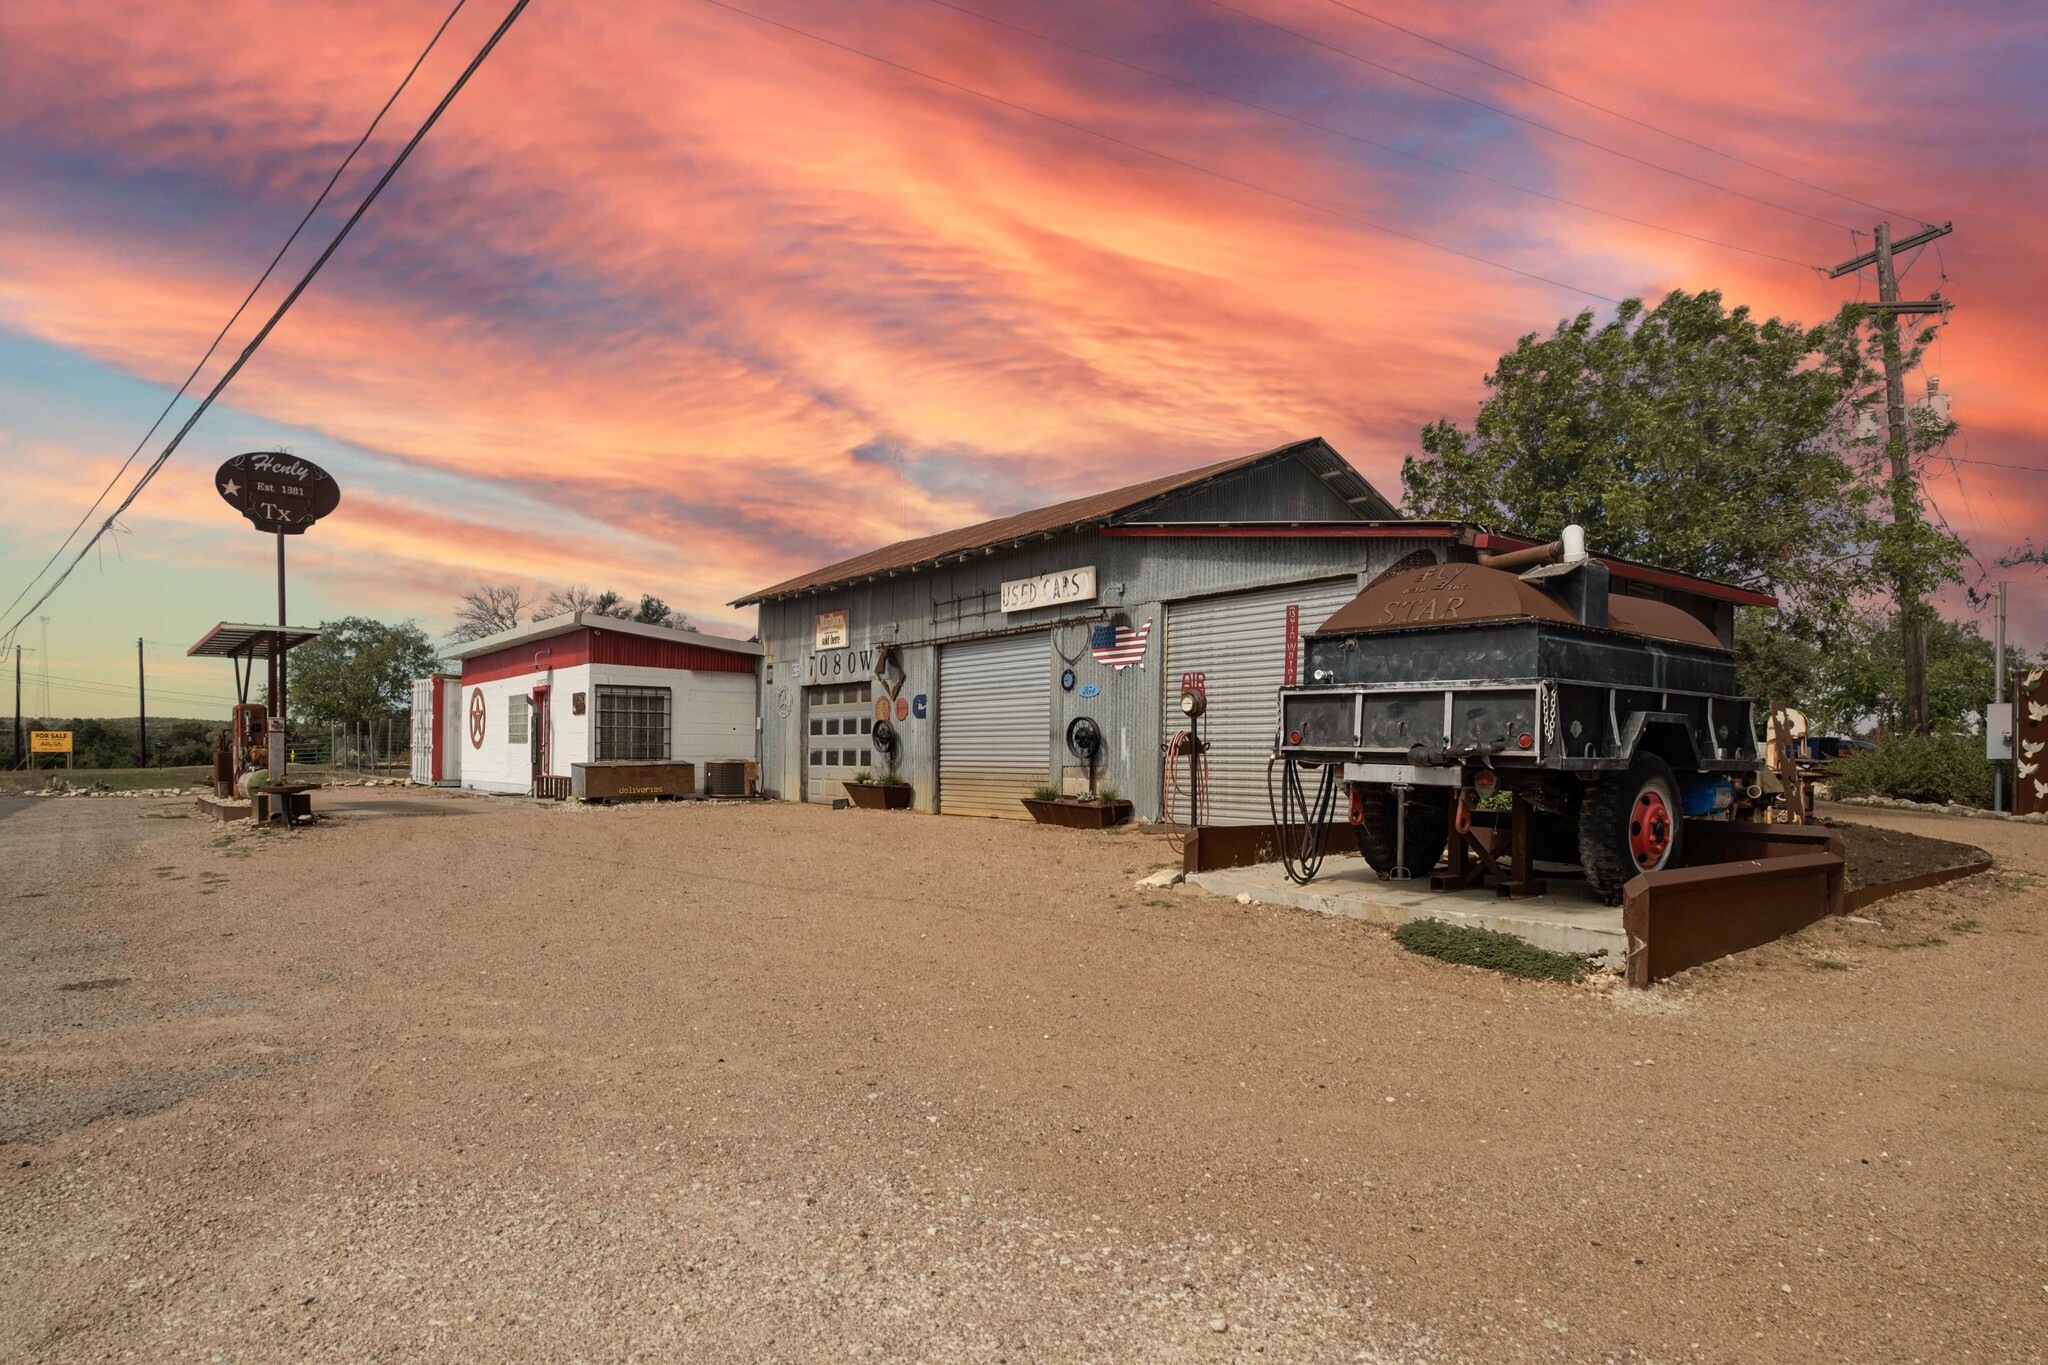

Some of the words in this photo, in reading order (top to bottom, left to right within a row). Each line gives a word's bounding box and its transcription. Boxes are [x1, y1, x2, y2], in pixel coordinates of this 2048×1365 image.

[251, 454, 309, 481] Henly
[260, 502, 292, 522] Tx
[1002, 583, 1037, 607] USED
[1043, 572, 1080, 599] CARS
[1447, 582, 1468, 591] THE
[1378, 596, 1465, 624] STAR
[1288, 606, 1296, 639] Rain
[821, 635, 830, 647] sold
[830, 634, 841, 645] here
[1286, 642, 1297, 684] Water
[1181, 671, 1206, 690] AIR
[618, 786, 664, 794] deliveries
